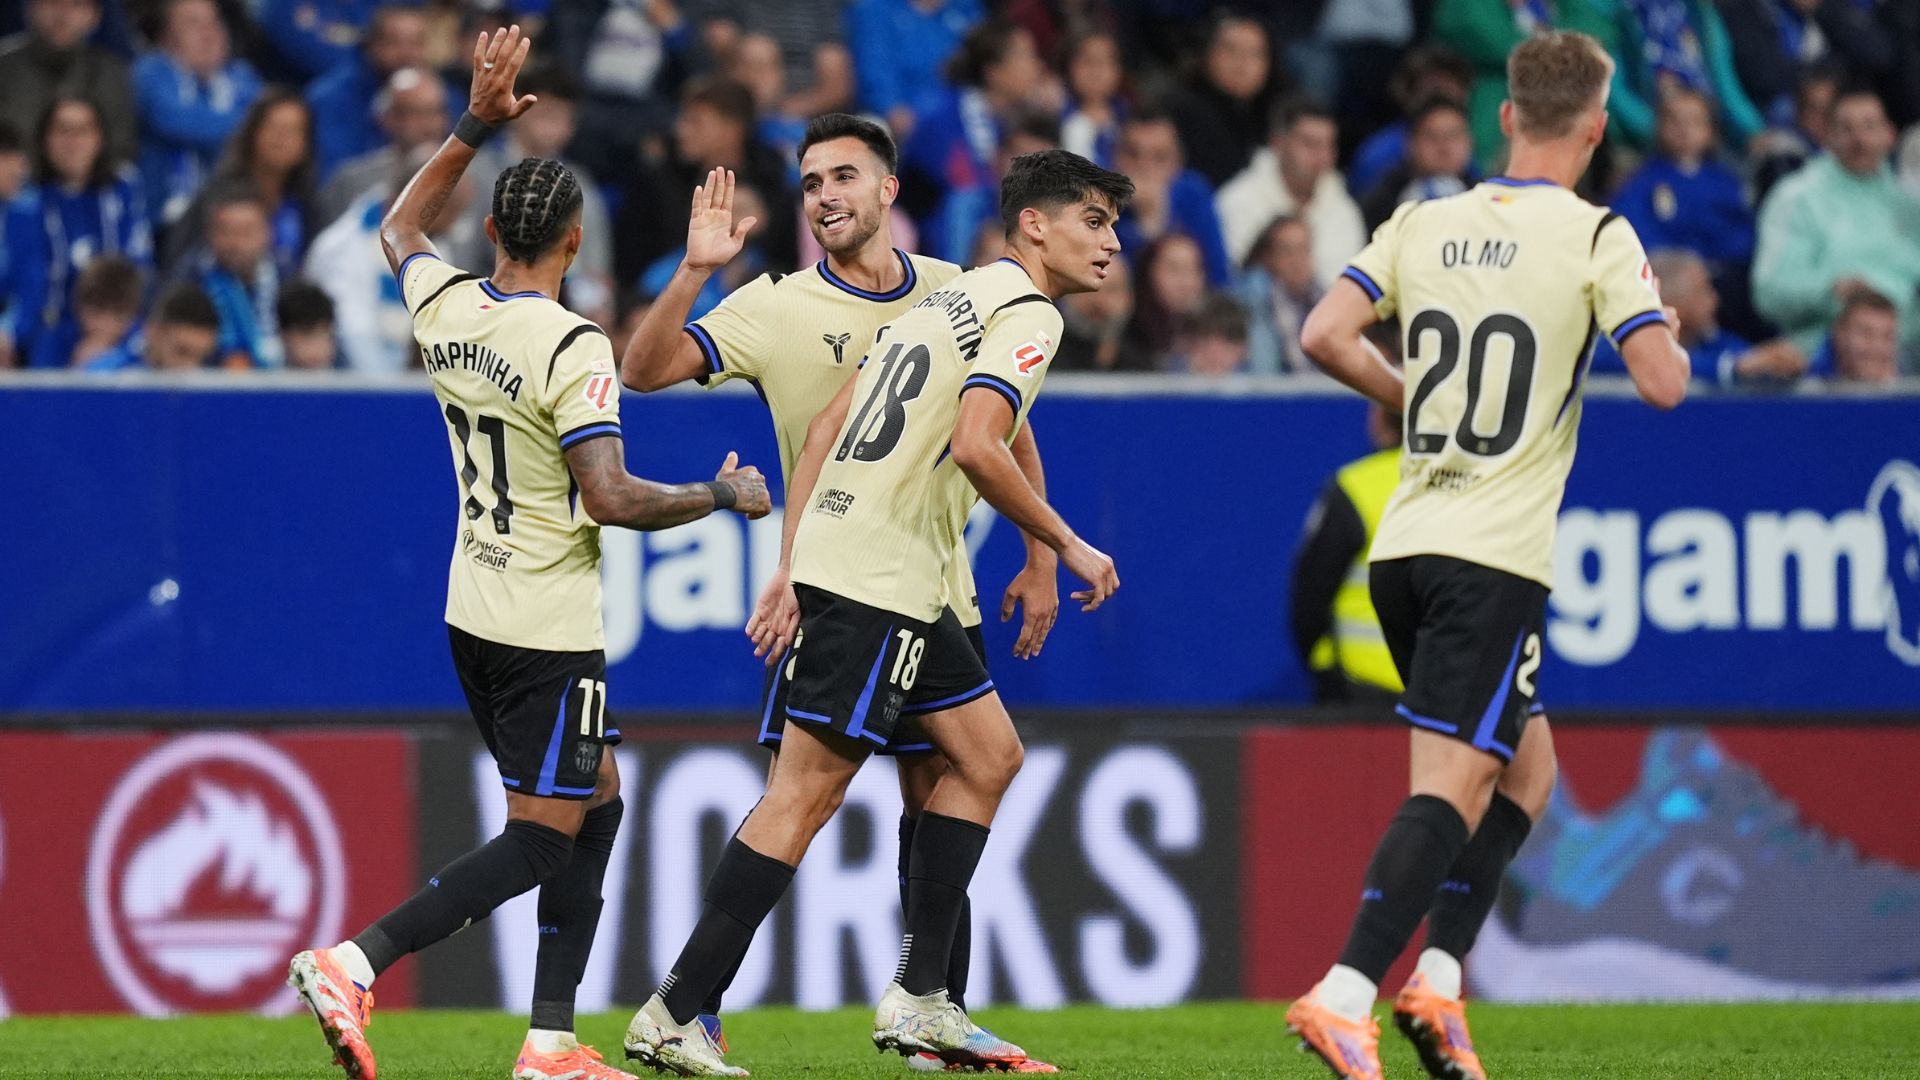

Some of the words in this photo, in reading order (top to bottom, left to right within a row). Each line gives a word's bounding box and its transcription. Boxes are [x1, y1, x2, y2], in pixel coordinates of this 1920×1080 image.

[1442, 240, 1518, 269] OLMO
[423, 341, 523, 402] RAPHINHA
[834, 343, 931, 462] 18
[1407, 310, 1537, 457] 20
[445, 403, 514, 535] 11
[890, 628, 925, 690] 18
[578, 678, 606, 738] 11
[473, 746, 1203, 1011] WORKS
